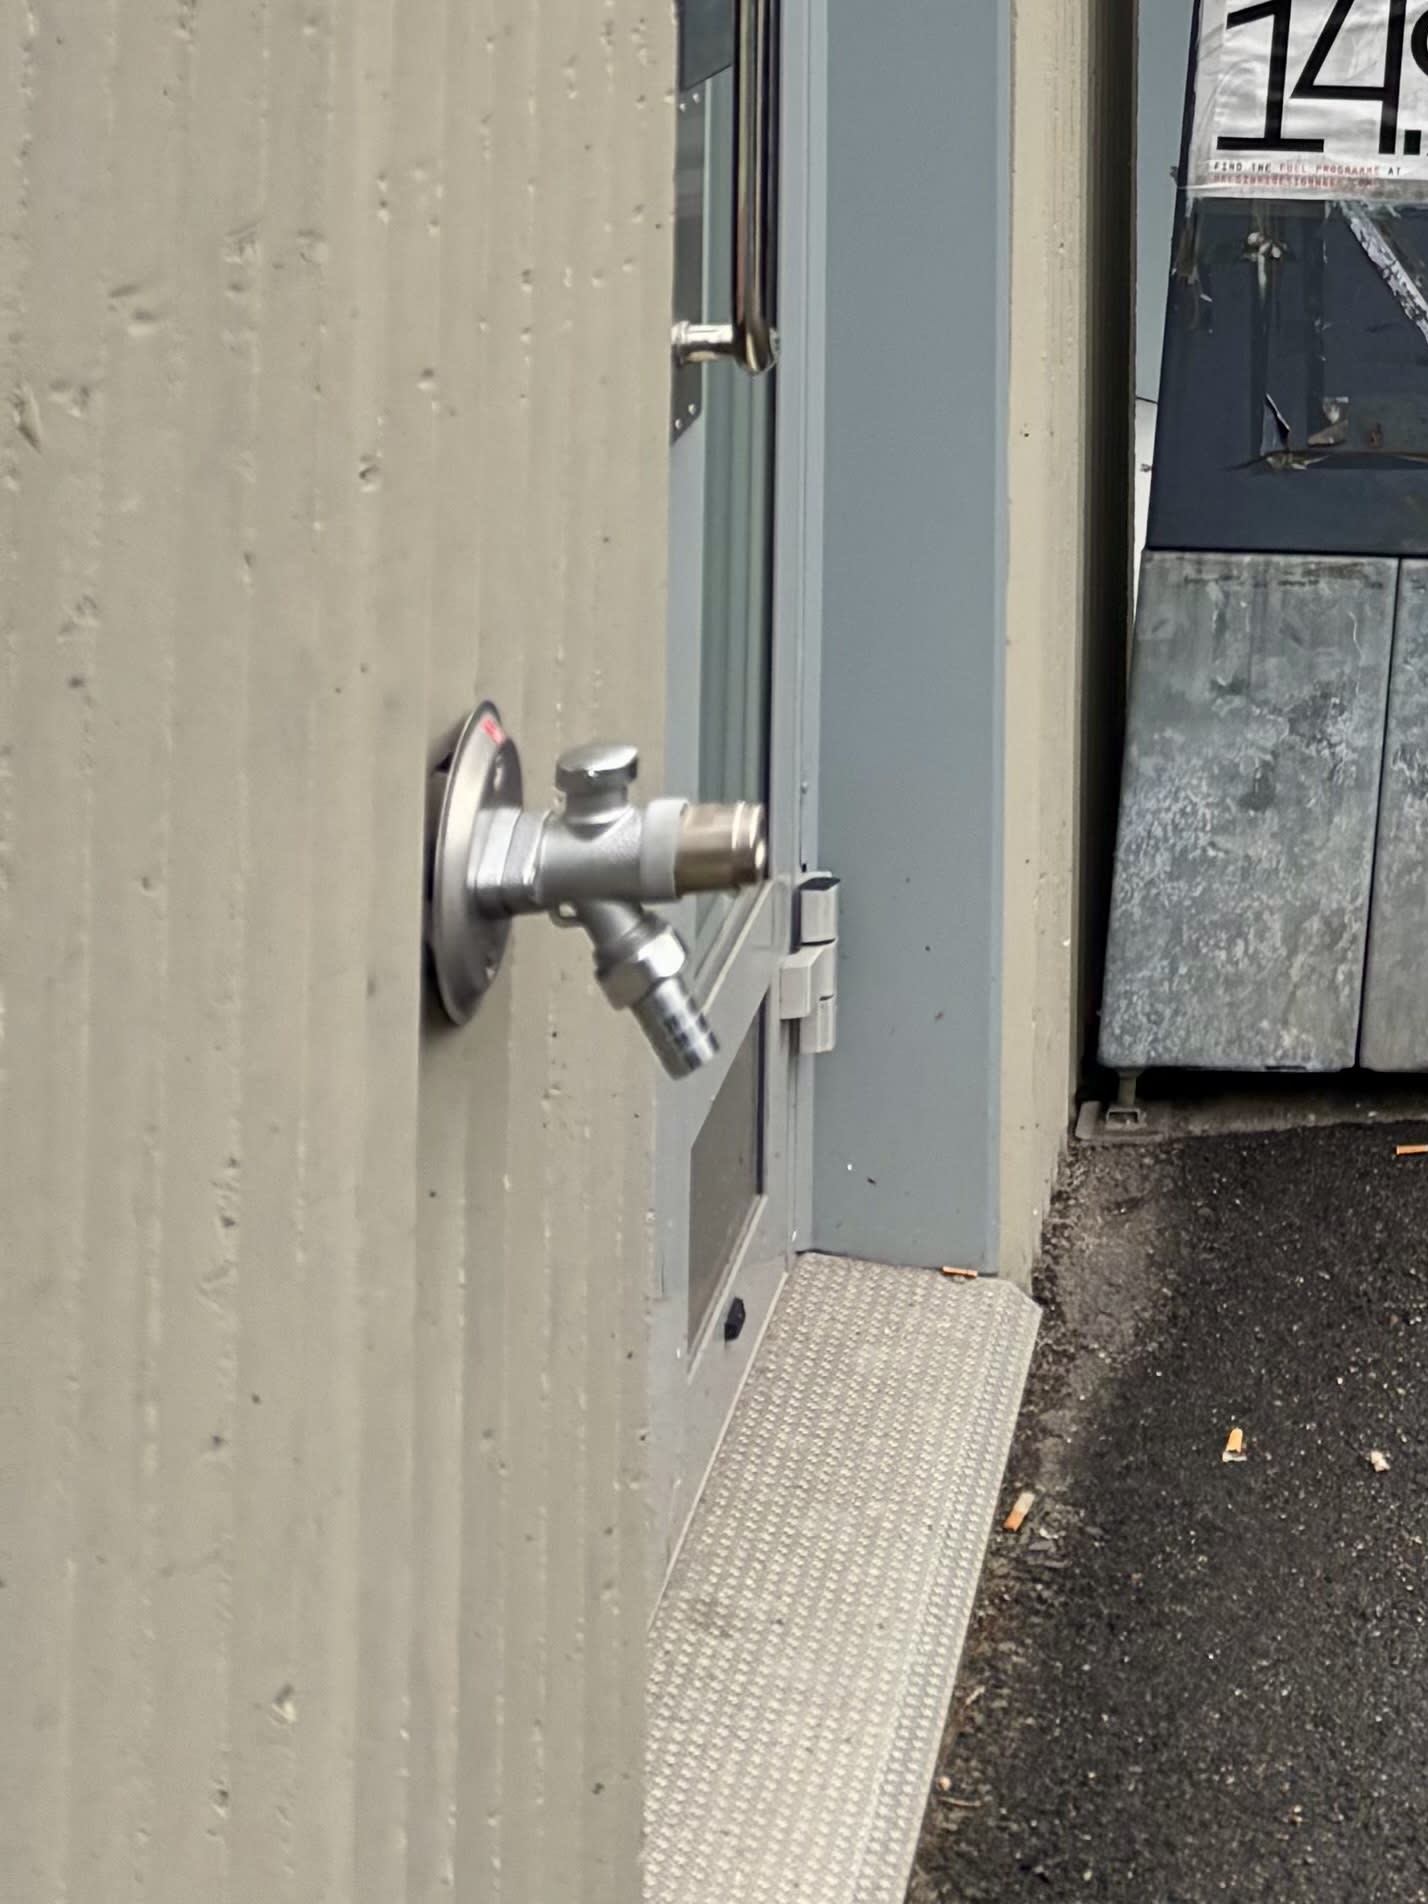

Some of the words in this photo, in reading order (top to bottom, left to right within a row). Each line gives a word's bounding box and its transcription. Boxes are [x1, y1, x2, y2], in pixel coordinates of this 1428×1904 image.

[1213, 162, 1242, 172] FIND
[1251, 163, 1272, 172] THE
[1279, 164, 1306, 174] FULL
